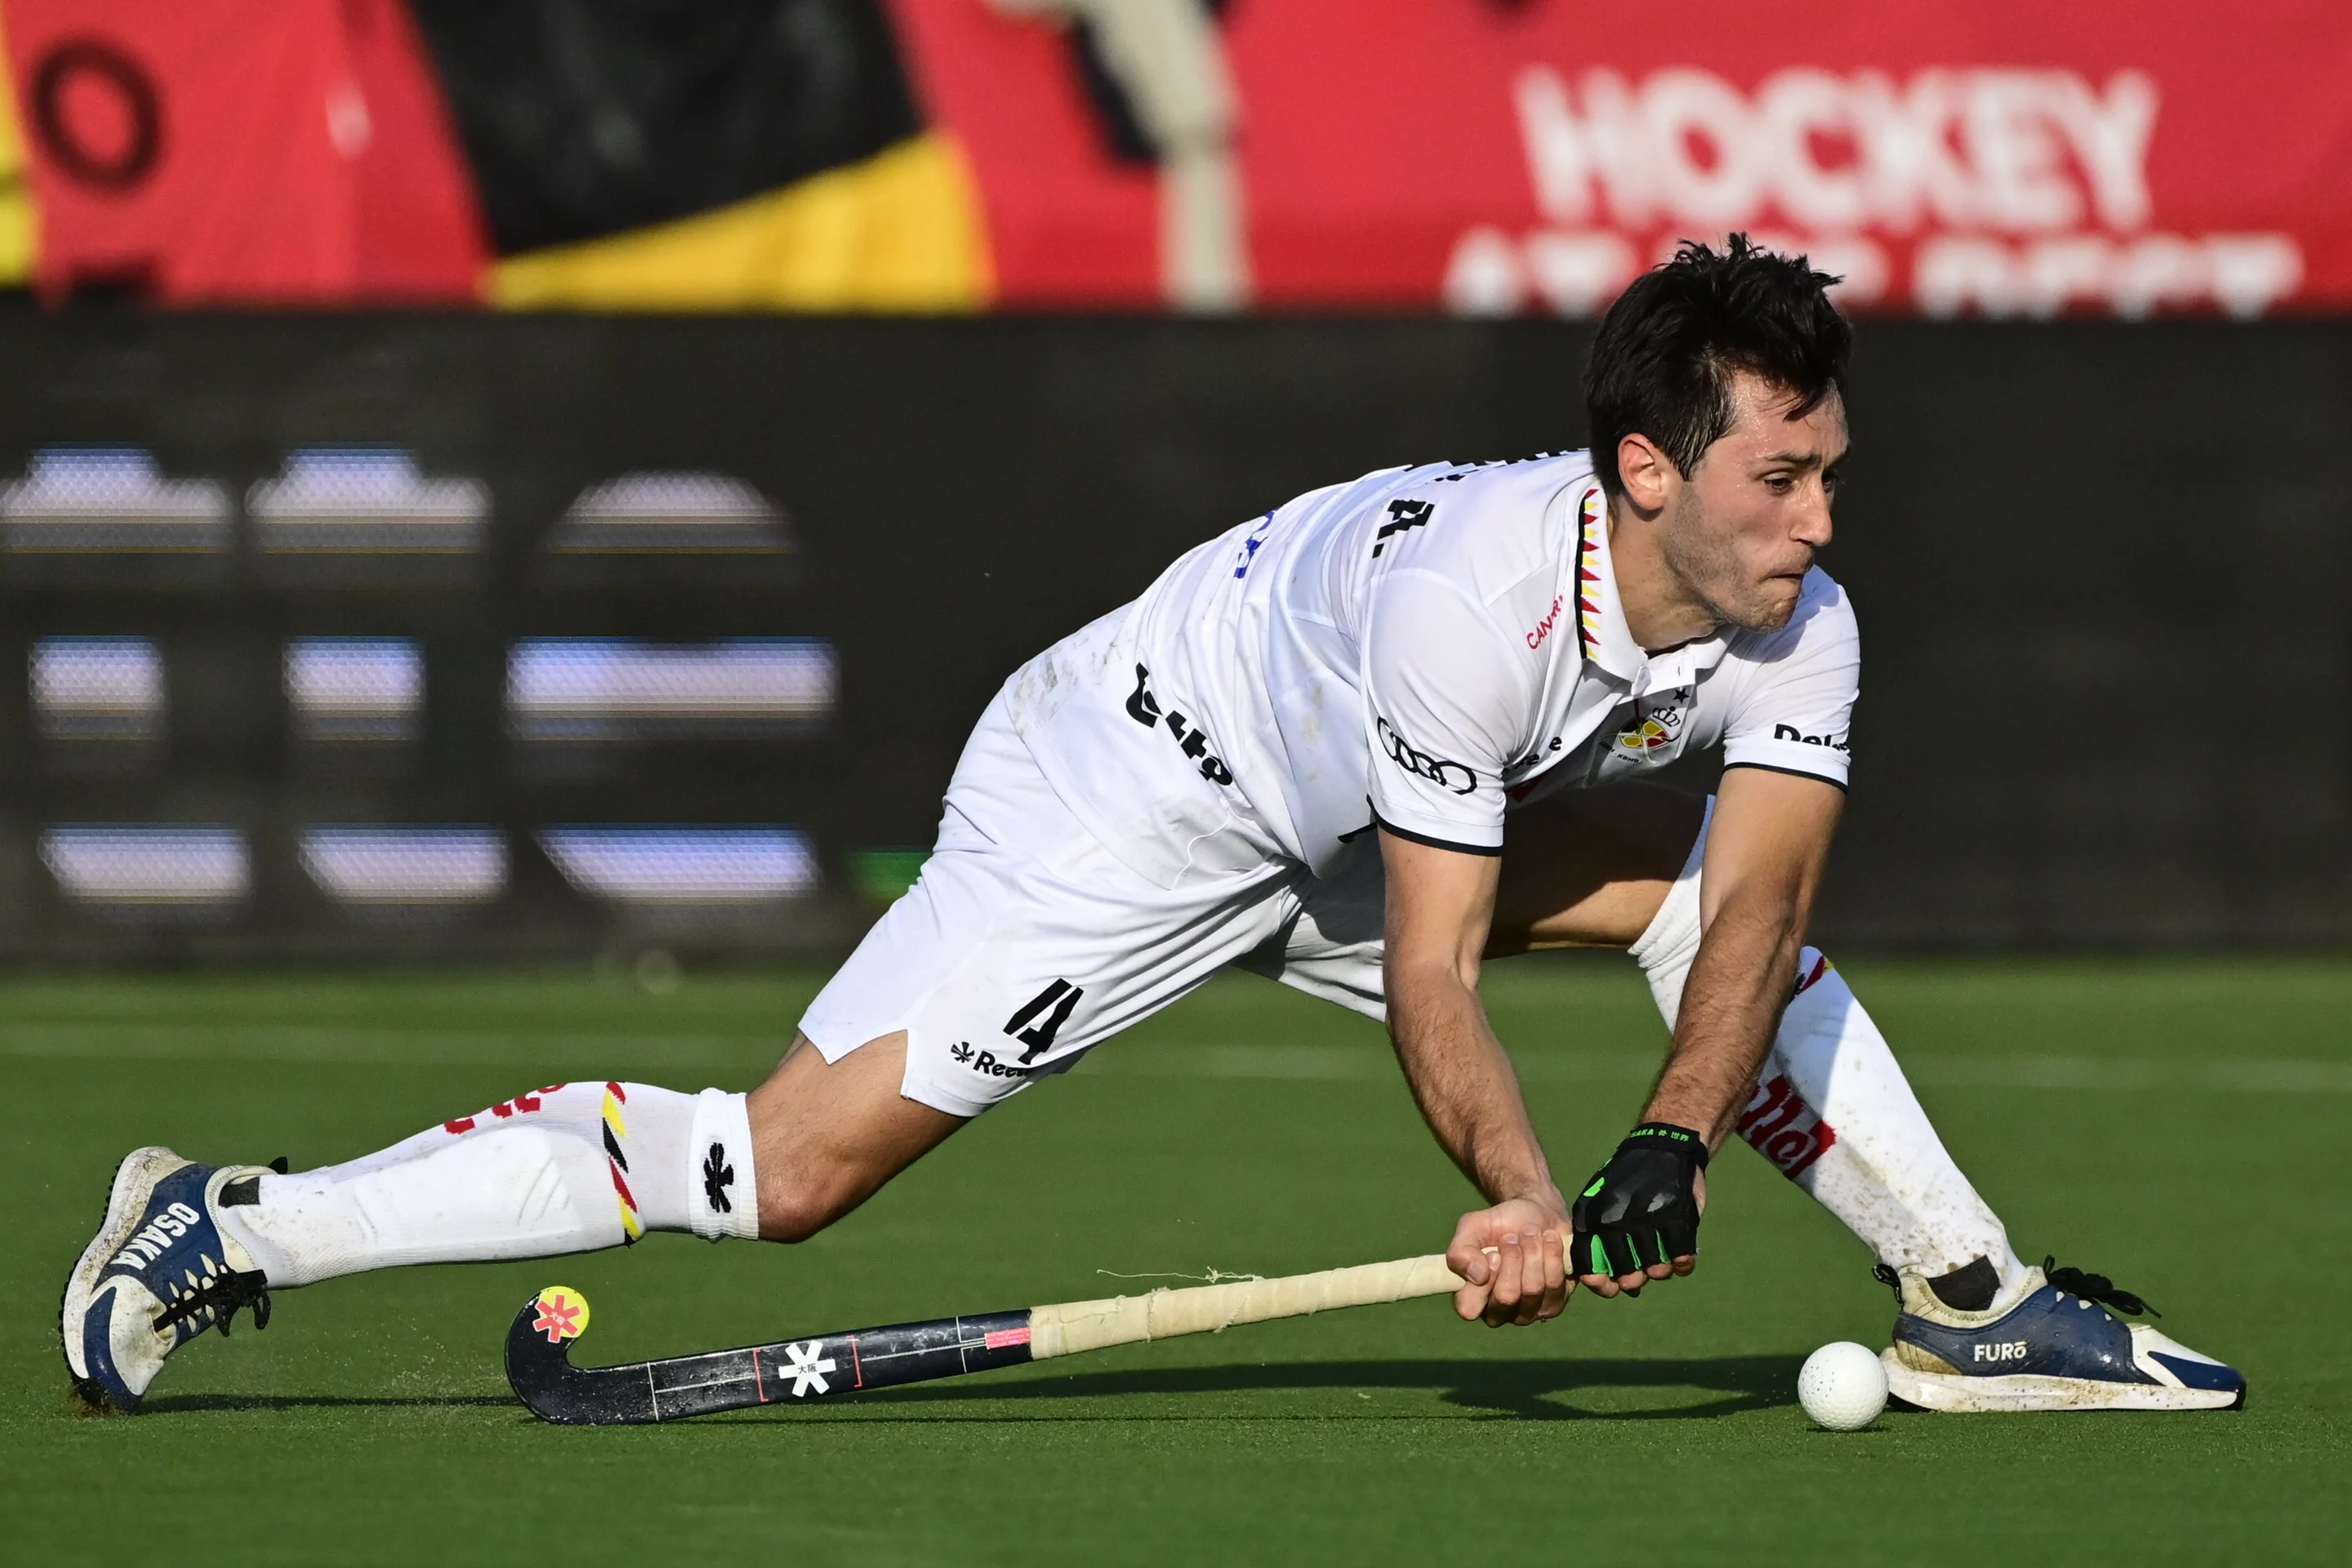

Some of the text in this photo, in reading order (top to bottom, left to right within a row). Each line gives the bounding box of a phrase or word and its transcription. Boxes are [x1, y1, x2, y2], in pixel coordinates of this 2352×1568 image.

[1511, 64, 2160, 232] HOCKEY
[1003, 978, 1085, 1066] 4
[109, 1202, 200, 1271] OSAKA
[797, 1362, 818, 1374] 大阪
